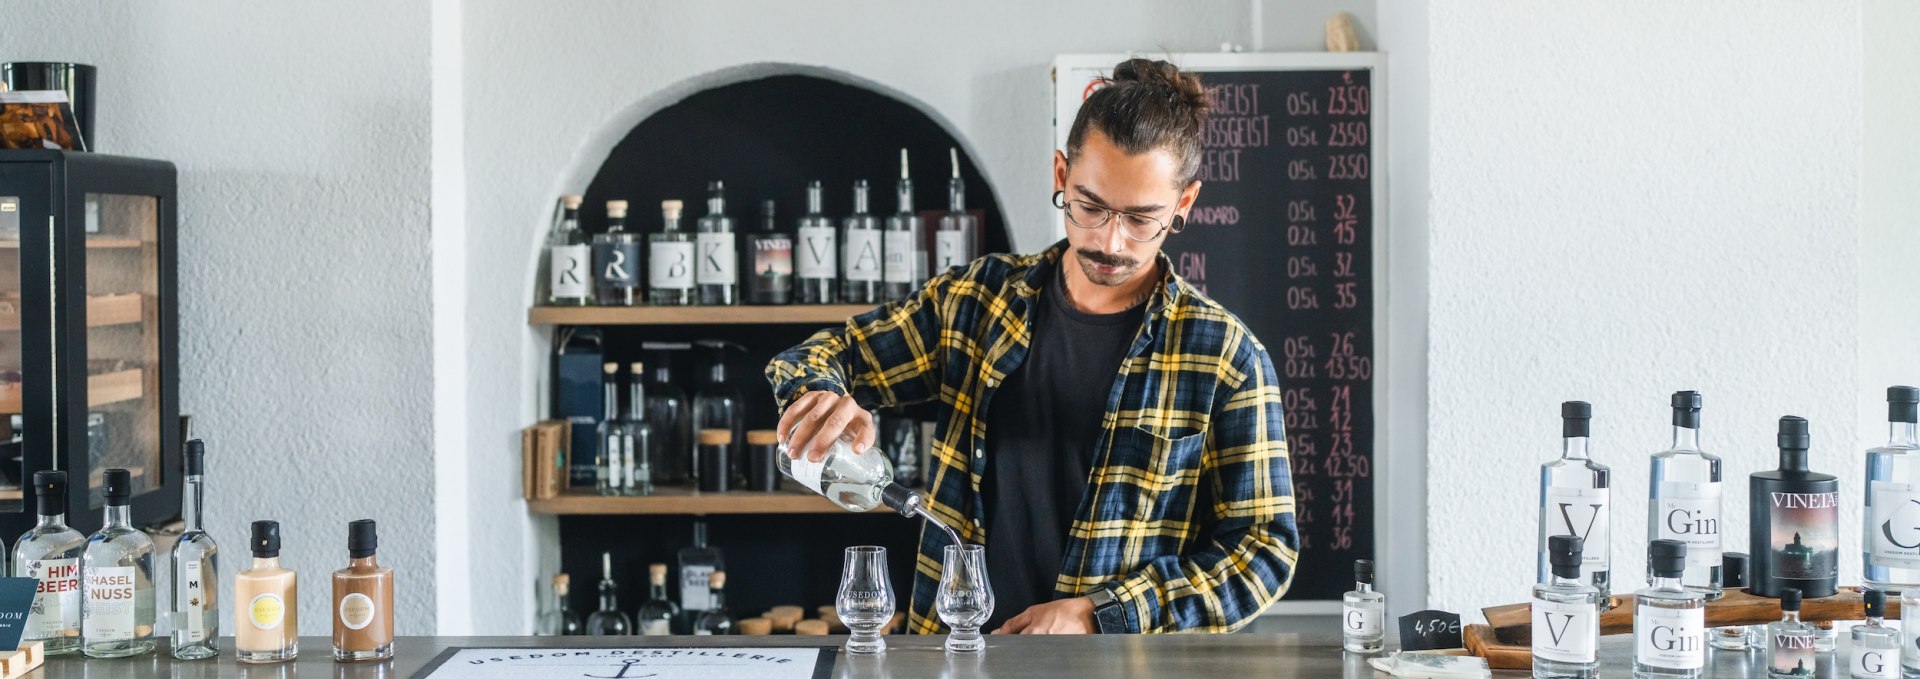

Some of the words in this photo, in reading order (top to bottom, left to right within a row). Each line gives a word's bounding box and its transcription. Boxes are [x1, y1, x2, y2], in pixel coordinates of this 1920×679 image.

[1205, 84, 1260, 115] GEIST
[1199, 115, 1270, 148] USSGEIST
[1198, 148, 1242, 181] GEIST
[1334, 194, 1356, 220] 32
[1334, 220, 1358, 245] 15
[704, 242, 723, 273] K
[806, 236, 832, 266] V
[854, 239, 879, 270] A
[559, 255, 581, 285] R
[1180, 251, 1206, 280] GIN
[1333, 252, 1355, 277] 32
[1334, 283, 1357, 309] 35
[1331, 333, 1355, 357] 26
[1331, 385, 1351, 412] 21
[1330, 411, 1352, 431] 12
[1330, 432, 1353, 458] 23
[1331, 480, 1353, 503] 31
[1770, 491, 1836, 509] VINETA
[1559, 502, 1603, 546] V
[1667, 508, 1718, 535] Gin
[1330, 526, 1352, 550] 36
[48, 565, 78, 578] HIM
[91, 576, 133, 586] HASEL
[189, 580, 198, 589] M
[37, 579, 78, 593] BEER
[91, 588, 133, 600] NUSS
[1347, 610, 1365, 630] G
[1544, 611, 1575, 647] V
[1650, 625, 1699, 651] Gin
[1775, 633, 1815, 649] VINE
[469, 651, 591, 665] USEDOM
[610, 650, 792, 664] DESTILLERIE
[1861, 651, 1885, 674] G
